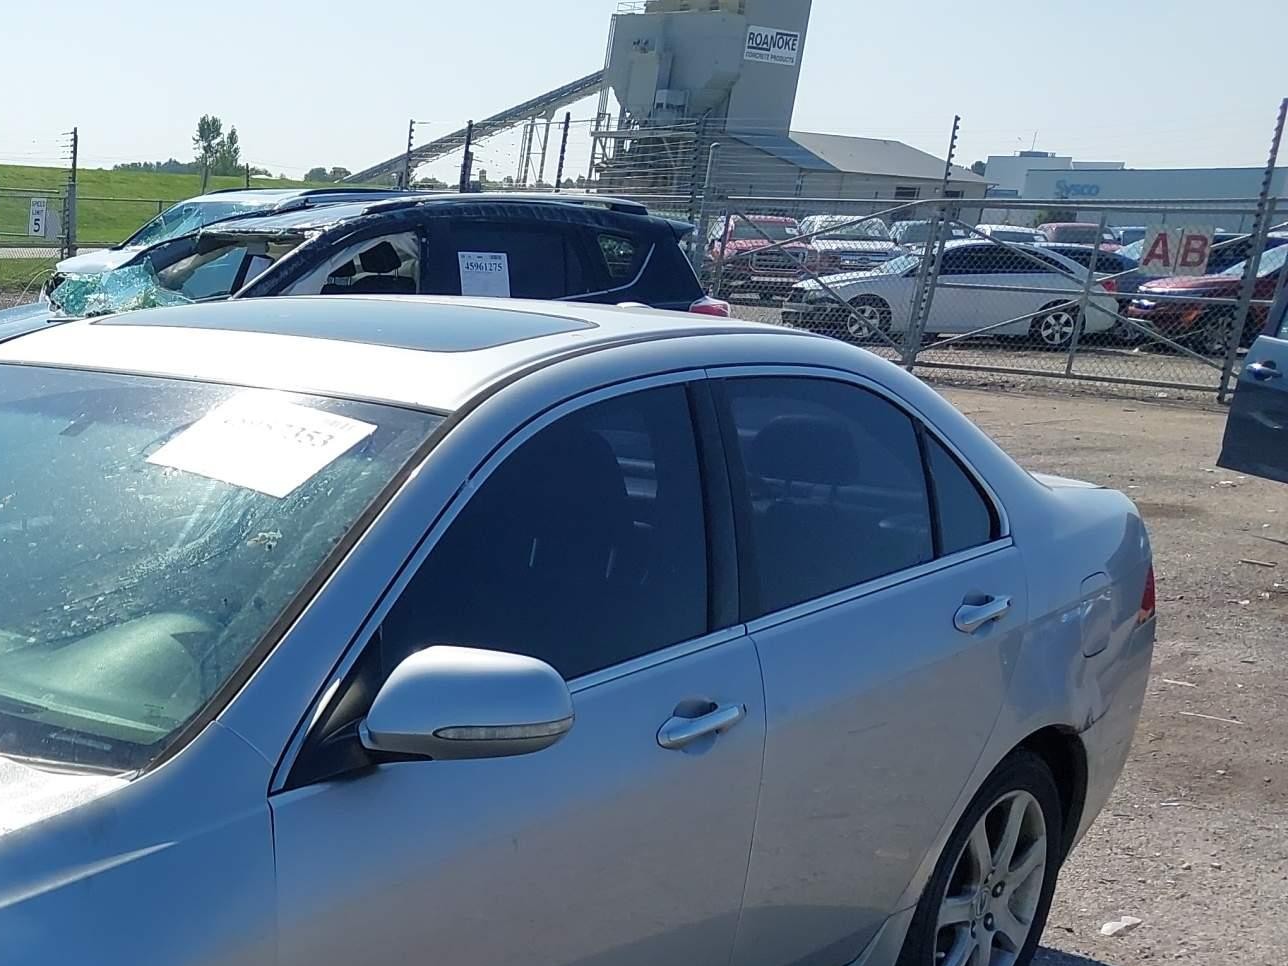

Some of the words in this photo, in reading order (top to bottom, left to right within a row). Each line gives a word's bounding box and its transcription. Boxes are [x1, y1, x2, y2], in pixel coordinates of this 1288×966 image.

[747, 32, 799, 51] ROANOKE
[745, 52, 770, 60] CONCRETE
[770, 54, 794, 63] PRODUCTS
[33, 218, 41, 232] 5
[464, 261, 503, 272] 45961275
